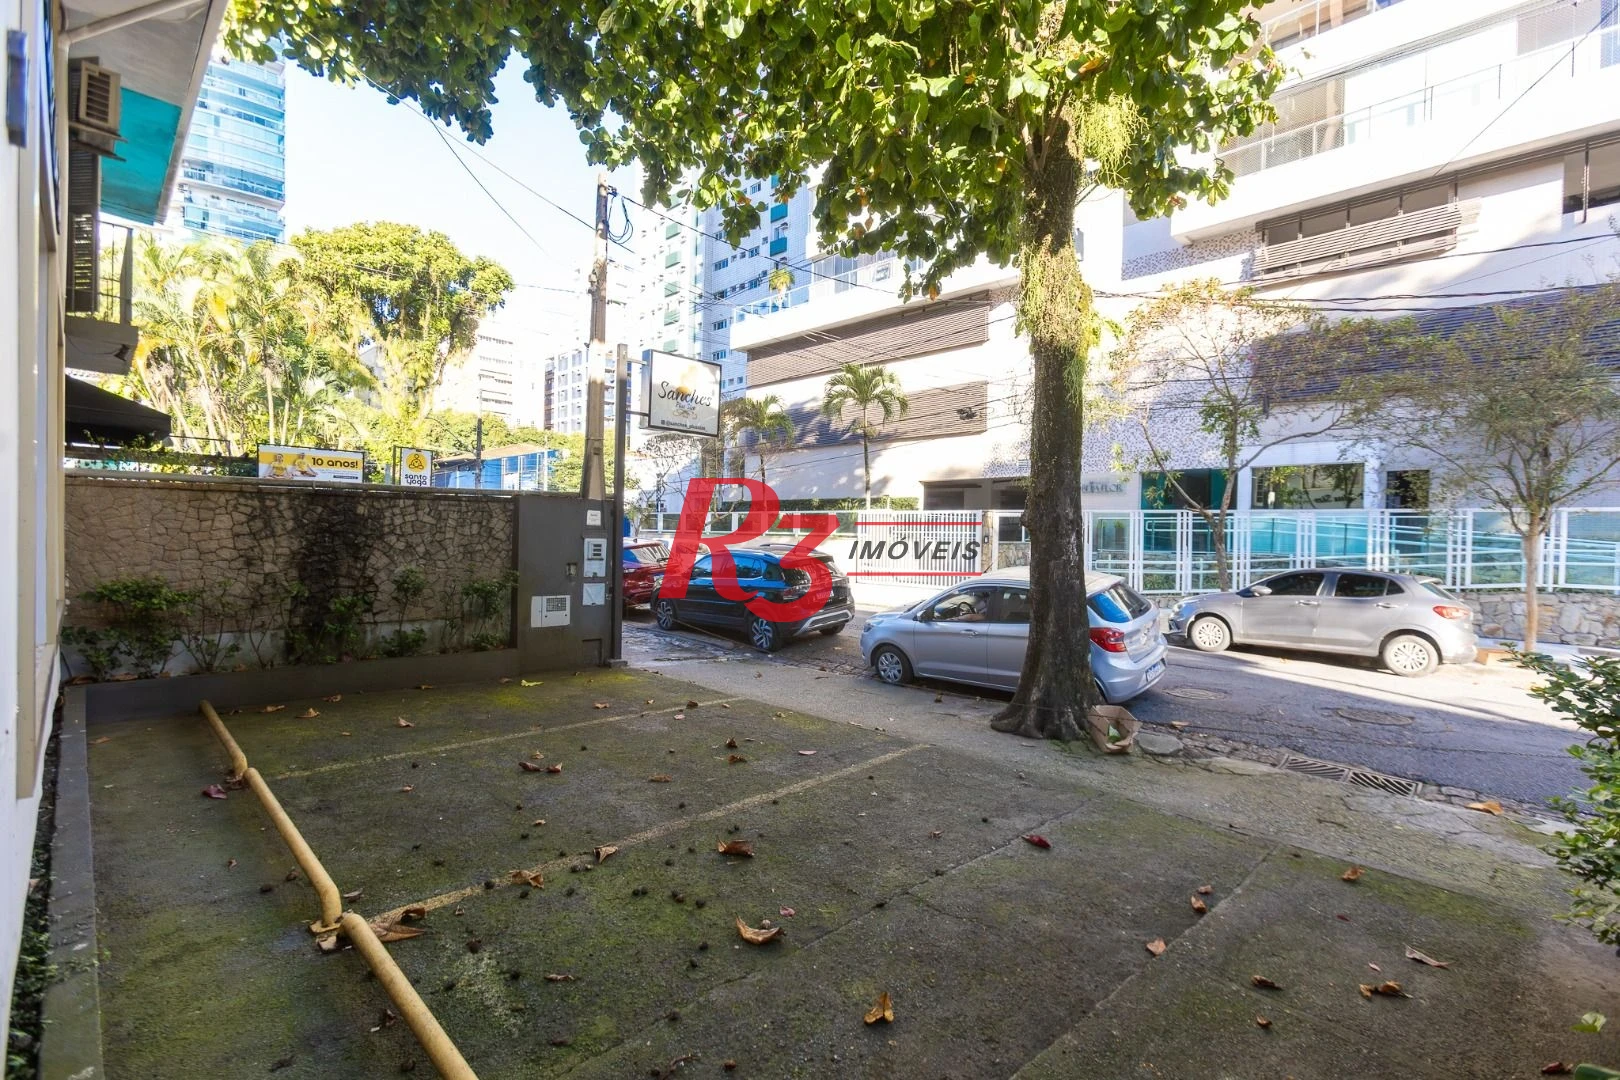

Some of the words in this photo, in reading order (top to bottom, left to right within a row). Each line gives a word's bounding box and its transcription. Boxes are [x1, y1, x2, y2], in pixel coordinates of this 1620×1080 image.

[658, 380, 712, 406] Sanches
[312, 457, 324, 466] 10
[327, 459, 358, 469] anos!
[406, 479, 427, 487] yoga
